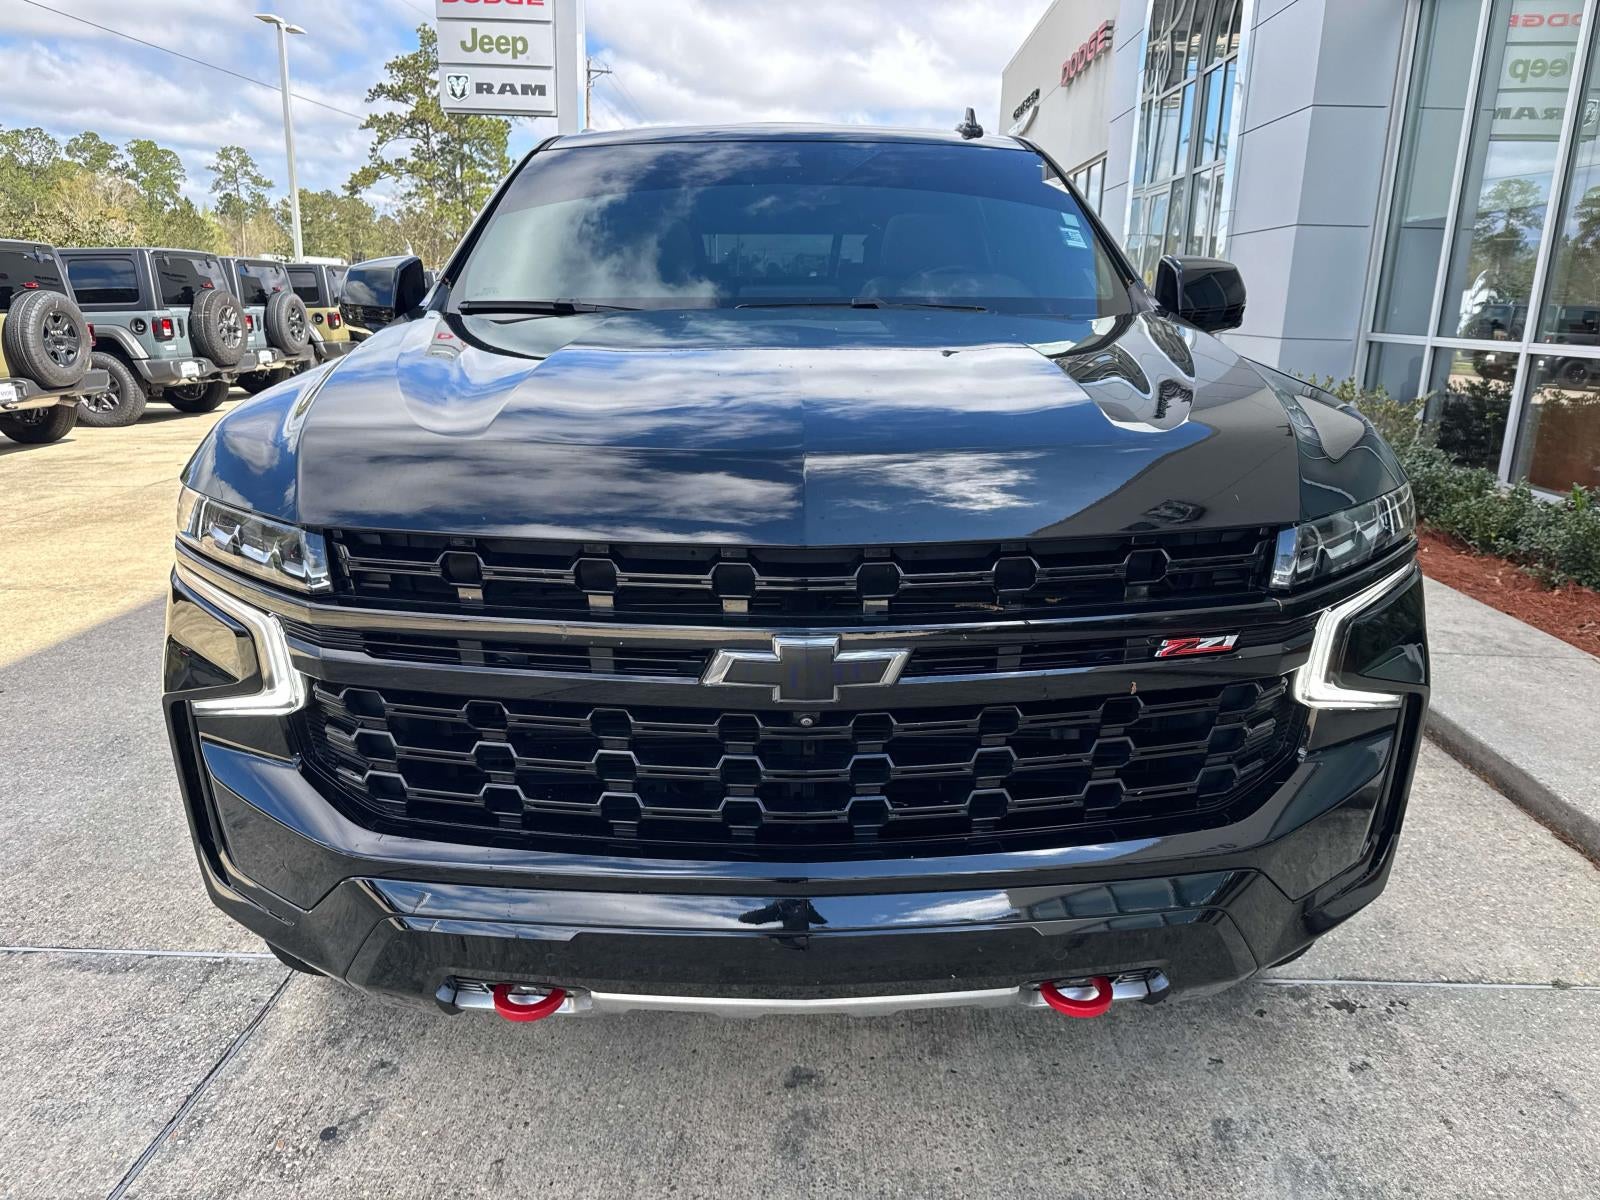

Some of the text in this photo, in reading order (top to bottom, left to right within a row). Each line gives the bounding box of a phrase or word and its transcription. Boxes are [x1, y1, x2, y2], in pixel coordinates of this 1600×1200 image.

[460, 27, 528, 59] Jeep
[1061, 19, 1115, 87] DODGE
[475, 82, 546, 96] RAM
[1154, 635, 1239, 657] Z71
